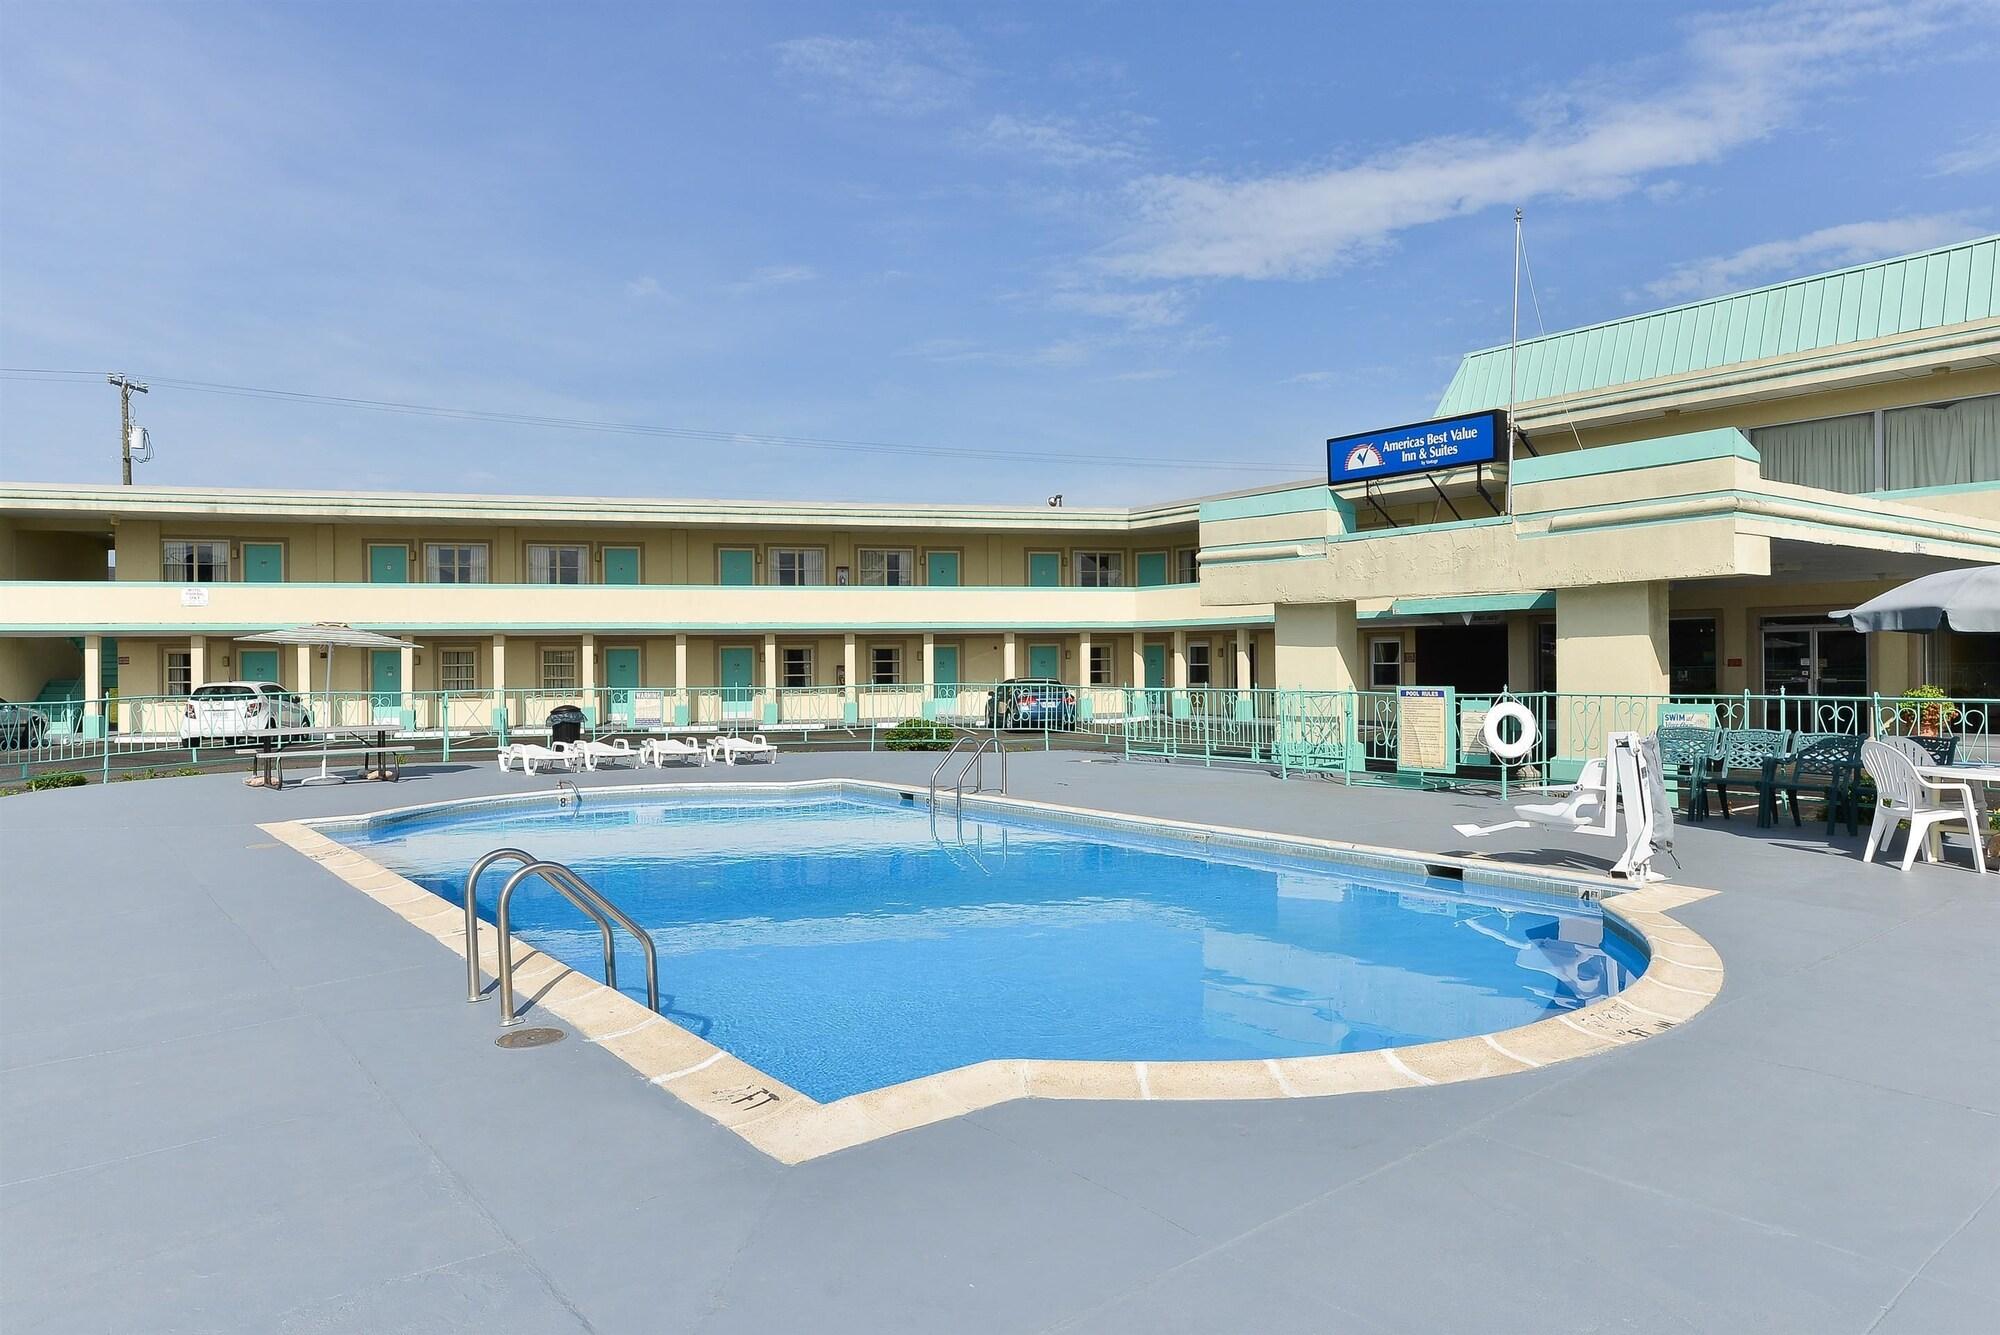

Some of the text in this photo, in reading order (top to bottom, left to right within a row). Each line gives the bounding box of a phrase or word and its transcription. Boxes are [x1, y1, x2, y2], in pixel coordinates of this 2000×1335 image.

[1382, 426, 1478, 453] Americas Best Value
[1401, 444, 1458, 462] Inn & Suites
[1664, 713, 1686, 721] SWIM
